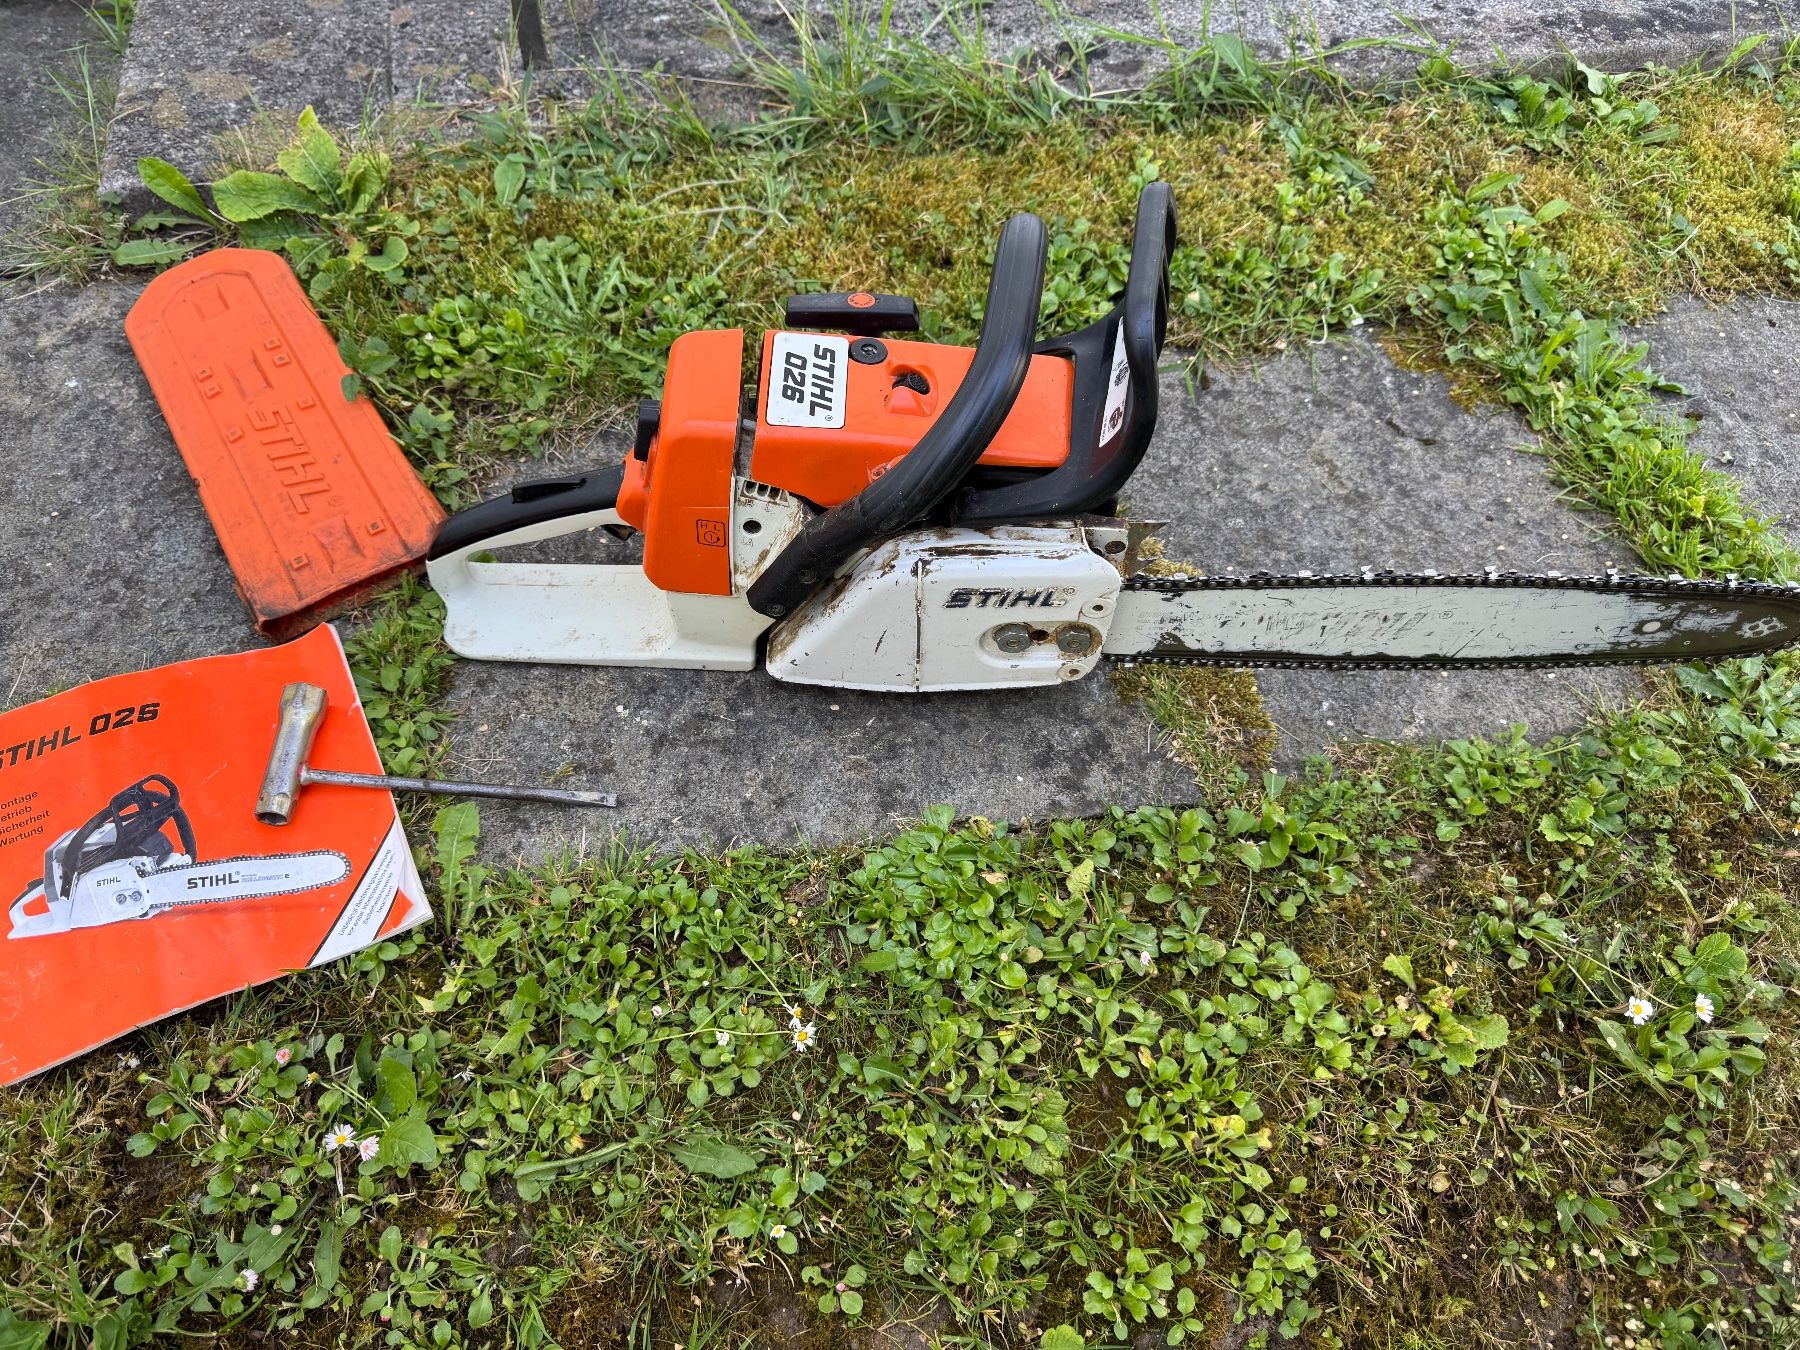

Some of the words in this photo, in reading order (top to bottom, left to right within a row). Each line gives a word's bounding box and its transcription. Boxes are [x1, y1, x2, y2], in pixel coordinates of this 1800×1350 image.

[781, 351, 807, 404] 026
[808, 343, 836, 417] STIHL
[246, 404, 332, 515] STIHL
[943, 587, 1067, 608] STIHL
[89, 702, 161, 736] 026
[0, 791, 38, 810] ontage
[0, 806, 32, 822] etrieb
[97, 876, 121, 887] STIHL
[187, 872, 240, 890] STIHL
